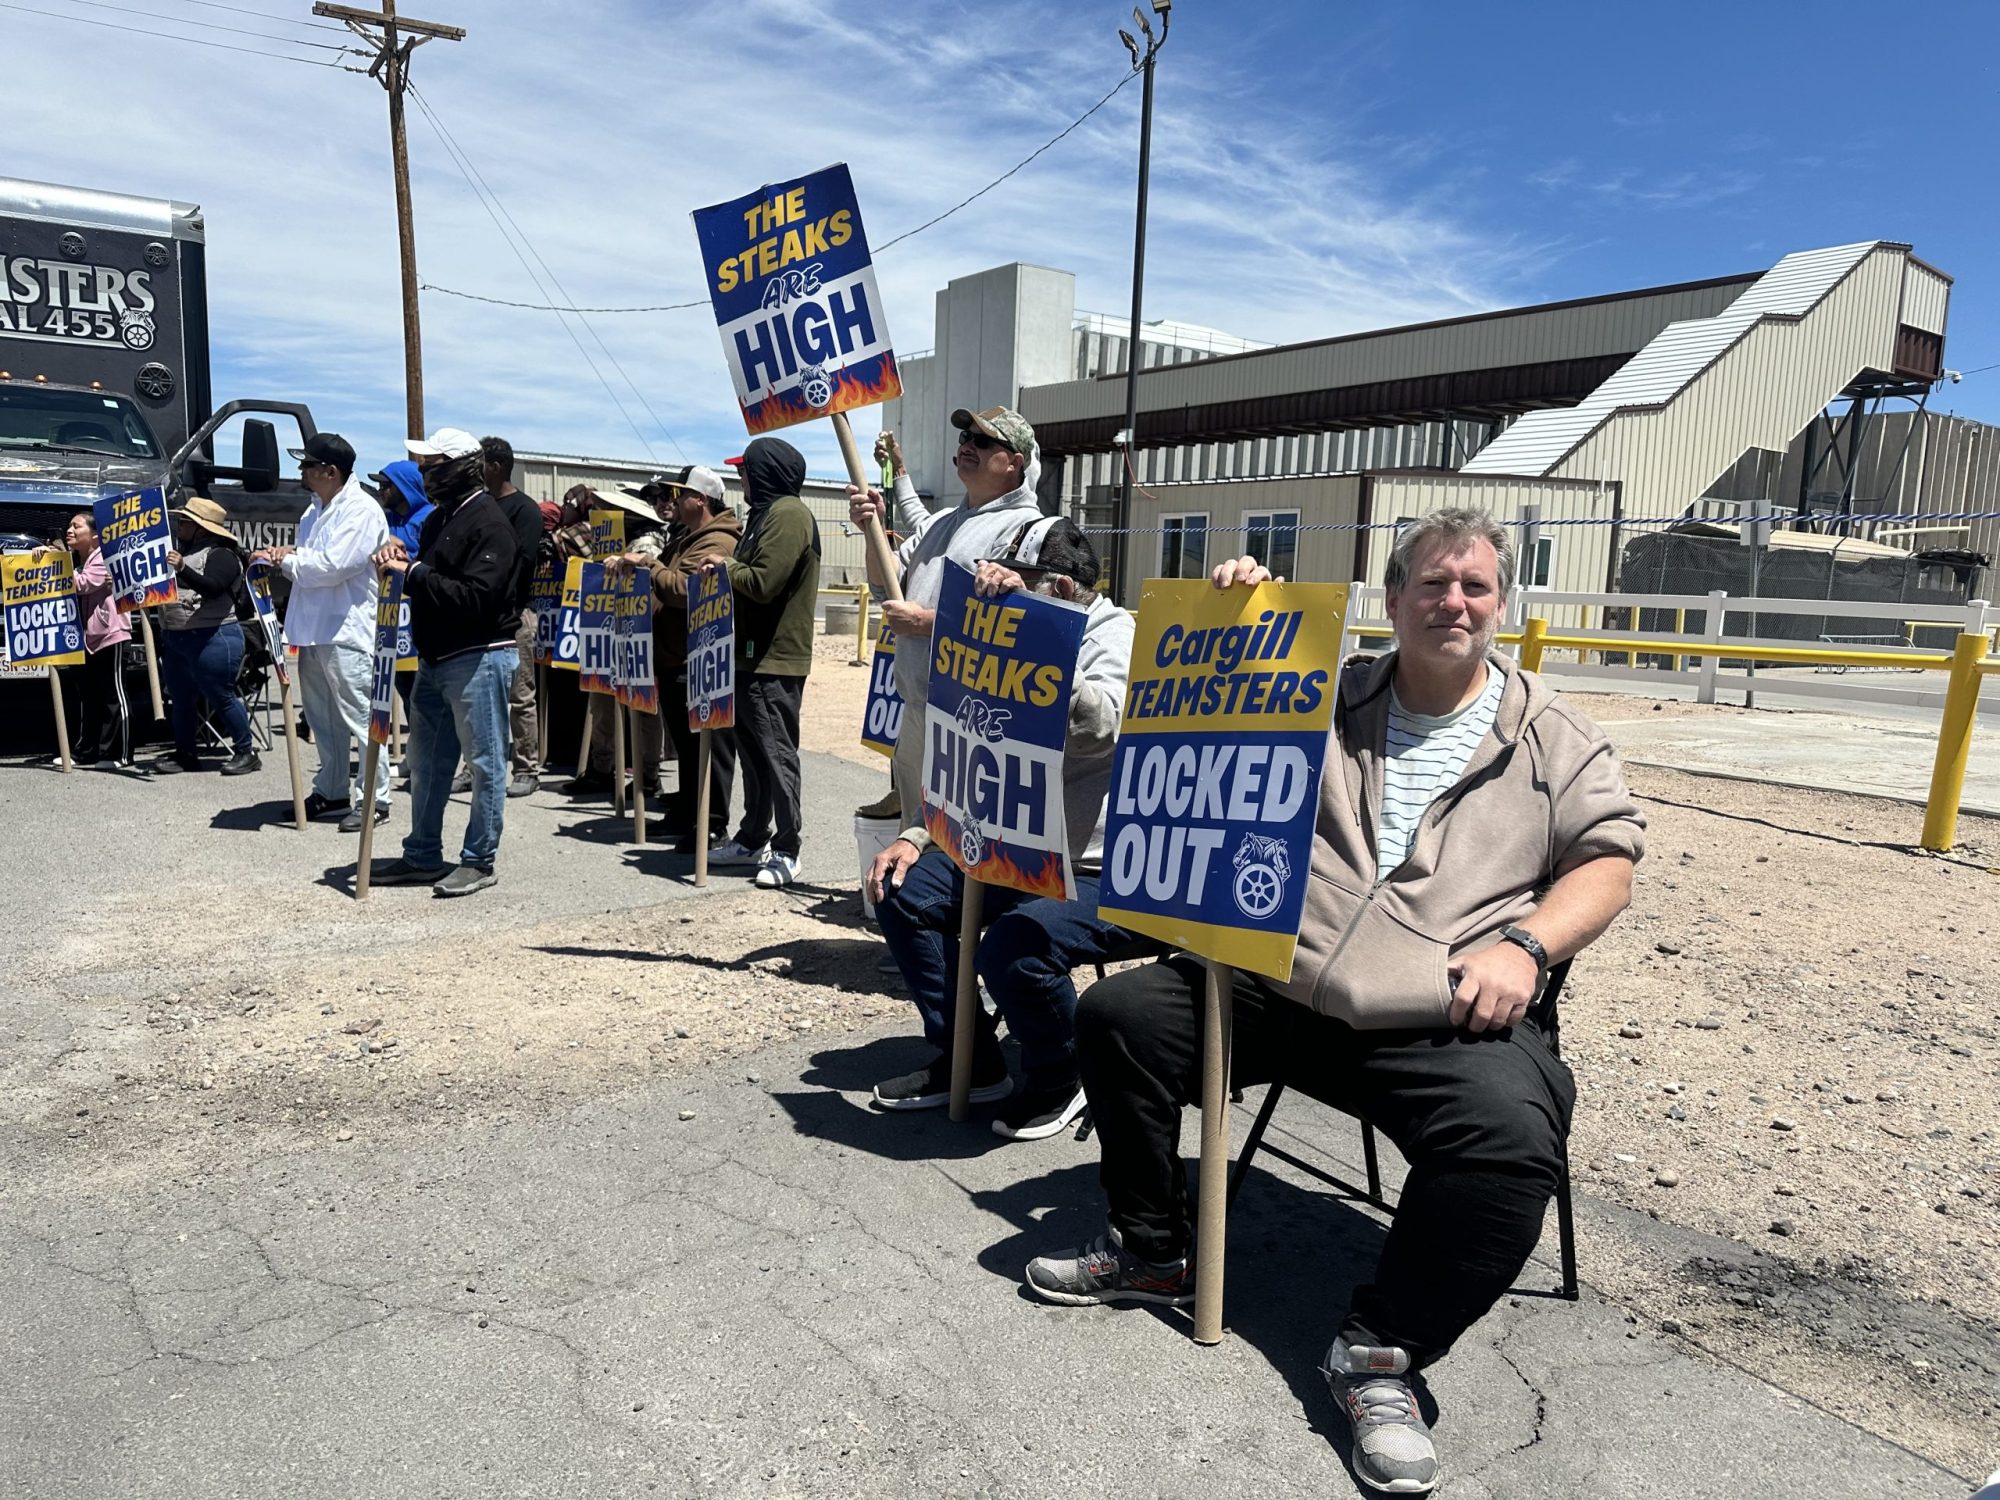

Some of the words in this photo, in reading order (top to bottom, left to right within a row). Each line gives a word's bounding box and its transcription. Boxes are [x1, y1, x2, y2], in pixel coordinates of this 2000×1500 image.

[744, 186, 806, 240] THE
[717, 209, 853, 293] STEAKS
[762, 263, 823, 310] ARE
[44, 309, 116, 339] 455
[734, 282, 877, 393] HIGH
[102, 507, 162, 545] STEAKS
[113, 494, 142, 520] THE
[109, 543, 169, 593] HIGH
[118, 532, 147, 556] ARE
[6, 576, 73, 601] TEAMSTERS
[14, 560, 63, 583] Cargill
[10, 598, 77, 632] LOCKED
[689, 592, 731, 634] STEAKS
[696, 624, 718, 650] ARE
[962, 598, 1027, 648] THE
[14, 626, 59, 657] OUT
[1155, 609, 1304, 675] Cargill
[689, 643, 730, 700] HIGH
[936, 638, 1063, 707] STEAKS
[1126, 669, 1328, 719] TEAMSTERS
[956, 695, 1012, 743] ARE
[930, 722, 1046, 837] HIGH
[1116, 744, 1309, 823] LOCKED
[1111, 823, 1226, 906] OUT
